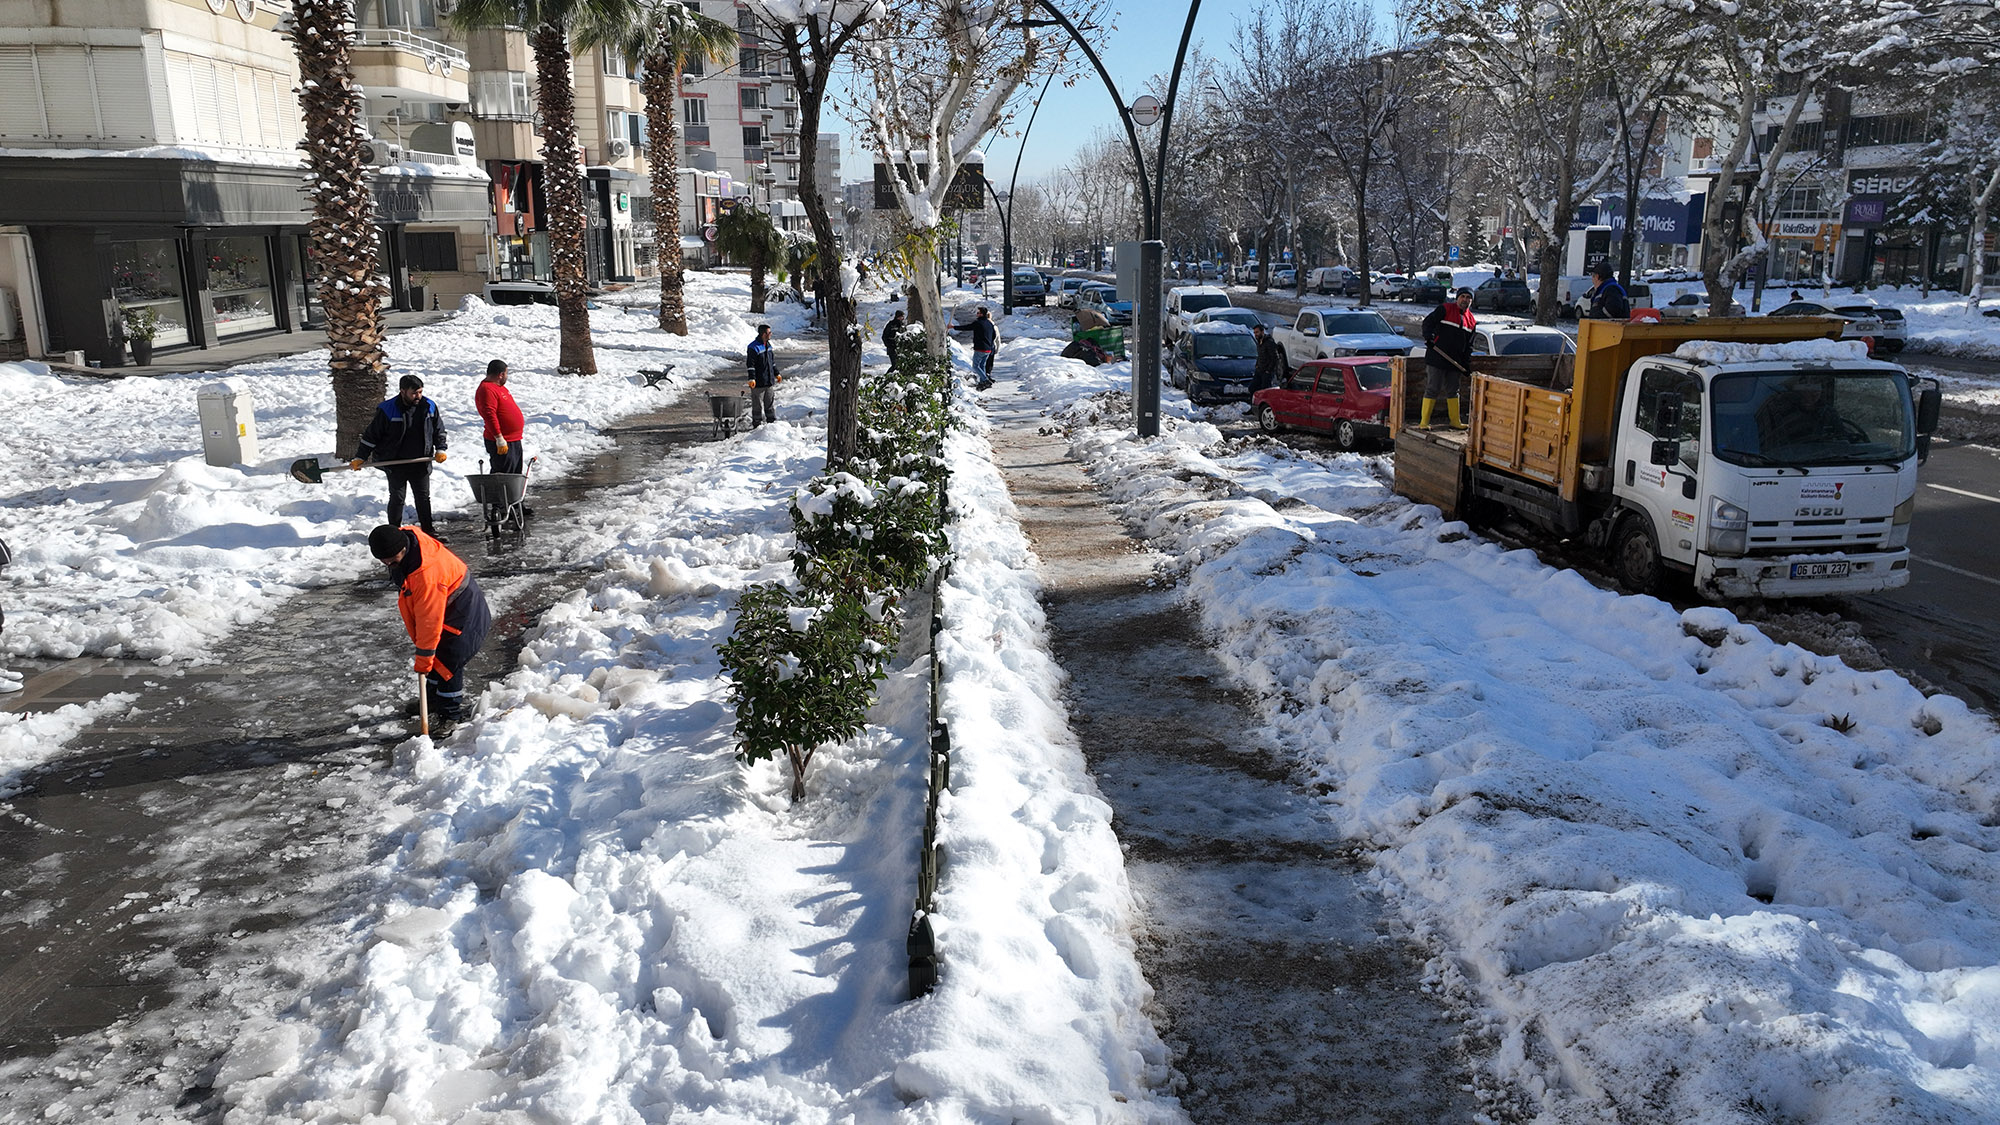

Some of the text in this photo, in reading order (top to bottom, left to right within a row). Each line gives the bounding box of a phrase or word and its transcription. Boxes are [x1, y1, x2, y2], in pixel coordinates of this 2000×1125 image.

[1853, 177, 1910, 194] SERG
[1855, 204, 1878, 217] ROYAL
[1795, 508, 1844, 516] ISUZU
[1797, 565, 1808, 575] 06
[1831, 563, 1847, 574] 237
